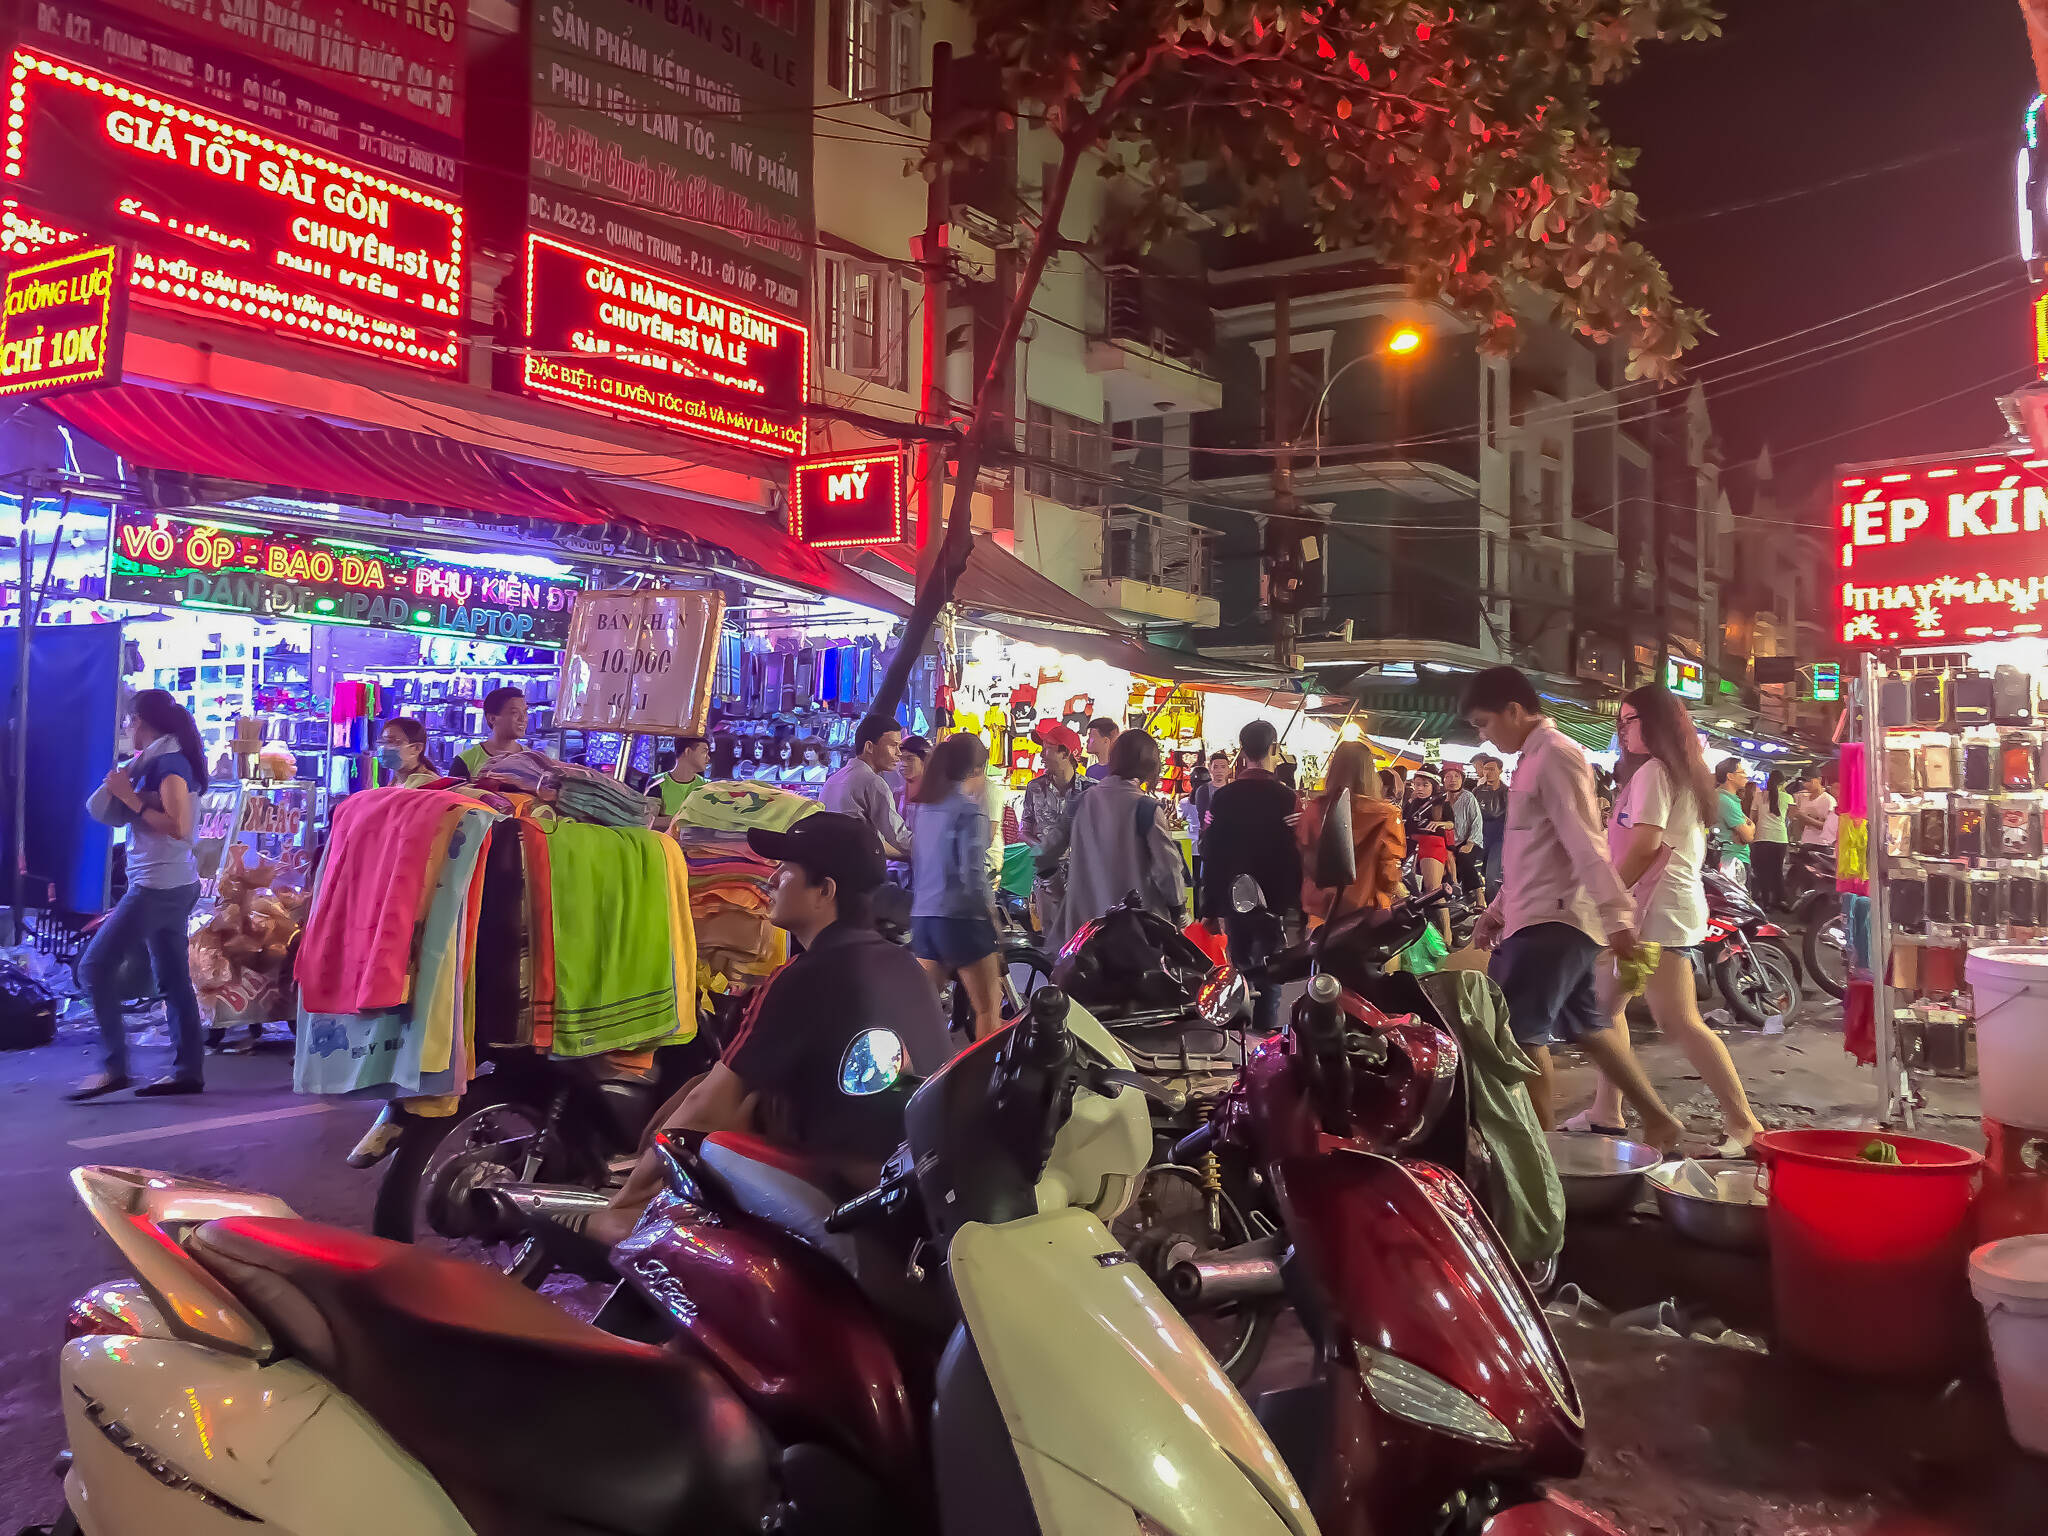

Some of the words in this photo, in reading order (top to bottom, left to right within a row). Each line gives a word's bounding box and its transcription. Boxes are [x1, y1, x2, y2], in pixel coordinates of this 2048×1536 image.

[684, 119, 715, 160] TÓC
[106, 110, 177, 159] GIÁ
[184, 136, 252, 182] TỐT
[258, 159, 316, 205] SÀI
[323, 182, 389, 229] GÒN
[606, 220, 643, 254] QUANG
[646, 234, 682, 266] TRUNG
[690, 250, 712, 278] P.11
[585, 266, 626, 298] CỬA
[630, 281, 683, 316] HÀNG
[686, 297, 726, 331] LAN
[729, 309, 778, 348] BÌNH
[0, 325, 45, 377] CHỈ
[48, 325, 100, 368] 10K
[701, 333, 725, 360] VÀ
[657, 392, 684, 413] TÓC
[709, 406, 726, 423] VÀ
[726, 412, 753, 431] MÁY
[828, 463, 870, 502] MỸ
[1853, 489, 1930, 547] ÉP
[122, 516, 174, 561] VỎ
[268, 546, 333, 582] BAO
[341, 556, 385, 590] DA
[415, 566, 473, 606] PHỤ
[481, 571, 541, 611] KIỆN
[439, 603, 534, 641] LAPTOP
[640, 612, 688, 631] KHN
